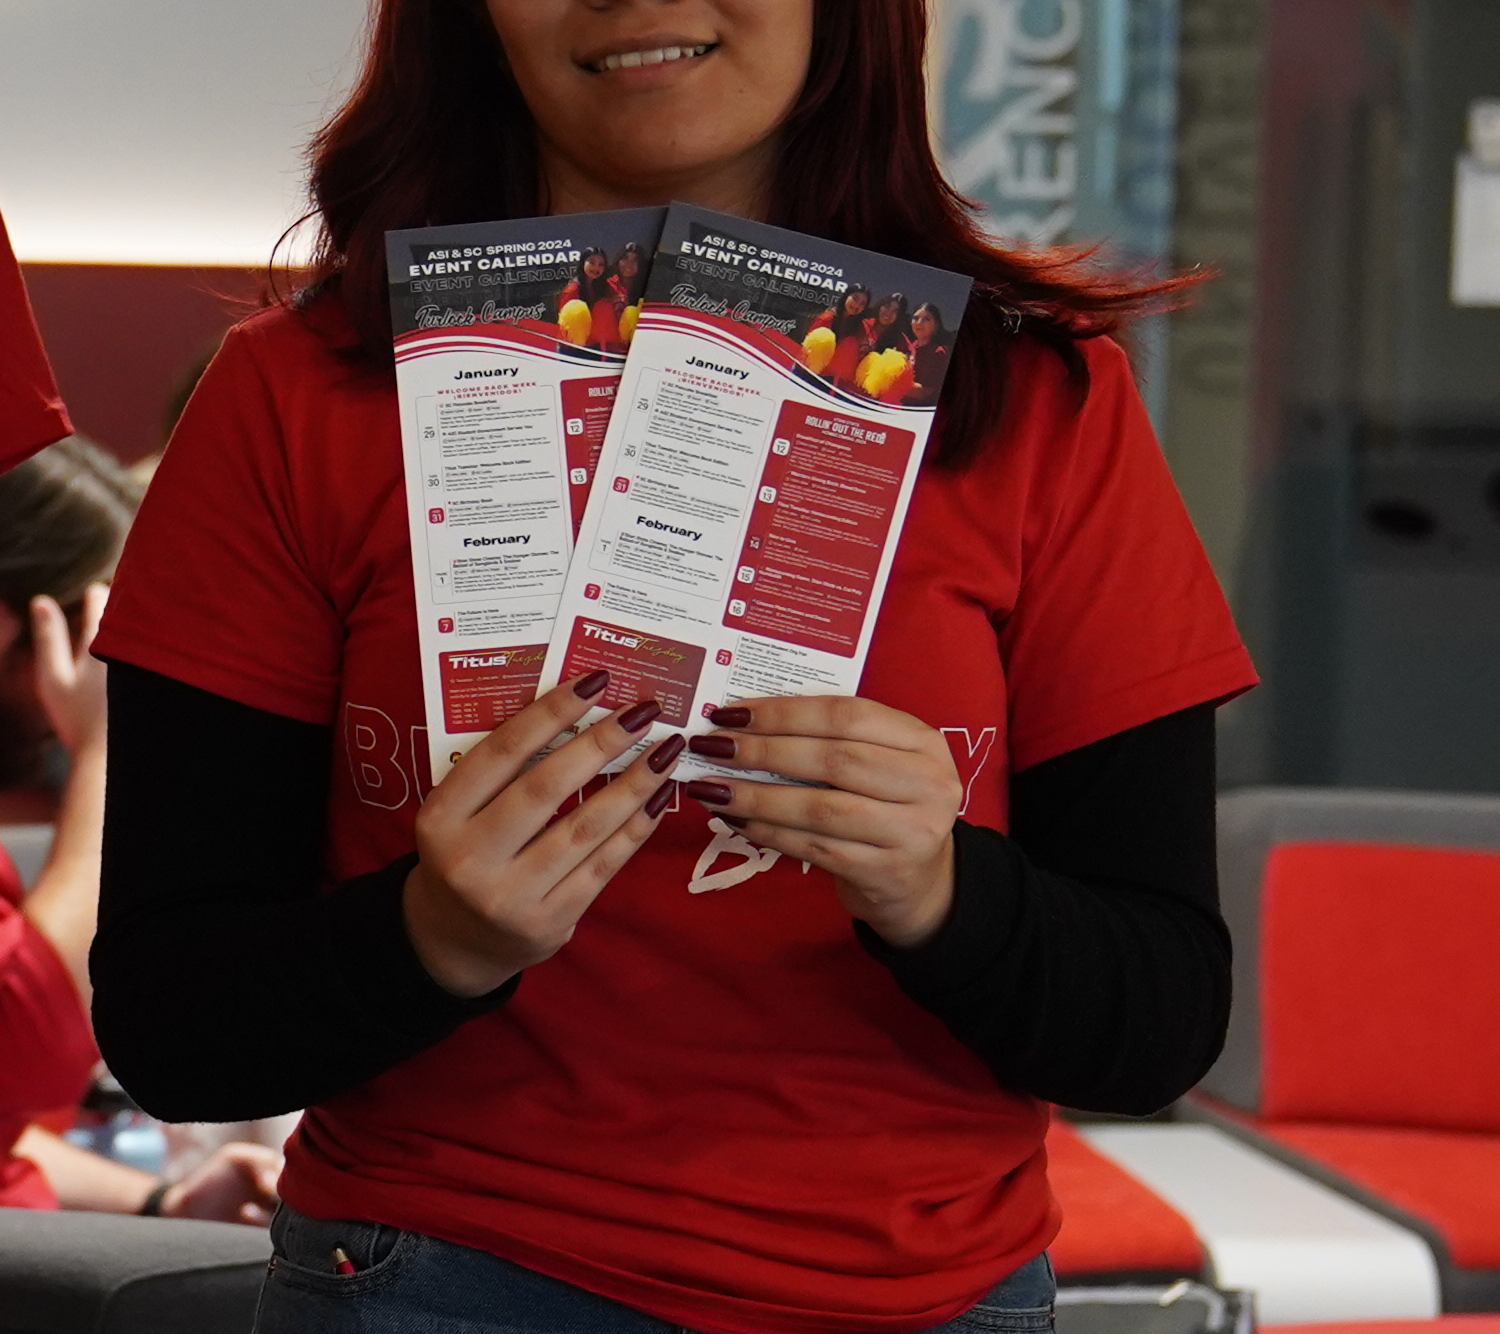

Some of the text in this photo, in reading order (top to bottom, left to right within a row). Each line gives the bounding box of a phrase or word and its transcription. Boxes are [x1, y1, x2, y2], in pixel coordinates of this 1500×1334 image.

[428, 239, 572, 260] ASI & SC SPRING 2024
[702, 235, 843, 277] ASI & SC SPRING 2024
[409, 251, 581, 276] EVENT CALENDAR
[676, 256, 739, 281] EVENT
[681, 241, 848, 293] EVENT CALENDAR
[410, 276, 473, 292] EVENT
[670, 283, 796, 334] Turlock Campus
[415, 300, 546, 330] Turlock Campus
[685, 356, 750, 380] January
[454, 367, 519, 380] January
[637, 401, 649, 411] 29
[571, 425, 579, 433] 12
[832, 422, 848, 433] OUT
[423, 431, 435, 439] 29
[624, 449, 636, 458] 30
[427, 479, 440, 487] 30
[615, 482, 627, 492] 31
[763, 492, 772, 501] 13
[431, 514, 442, 522] 31
[636, 515, 702, 541] February
[463, 535, 531, 547] February
[741, 572, 750, 582] 15
[589, 589, 595, 597] 7
[732, 605, 742, 614] 16
[443, 623, 448, 631] 7
[718, 656, 728, 664] 21
